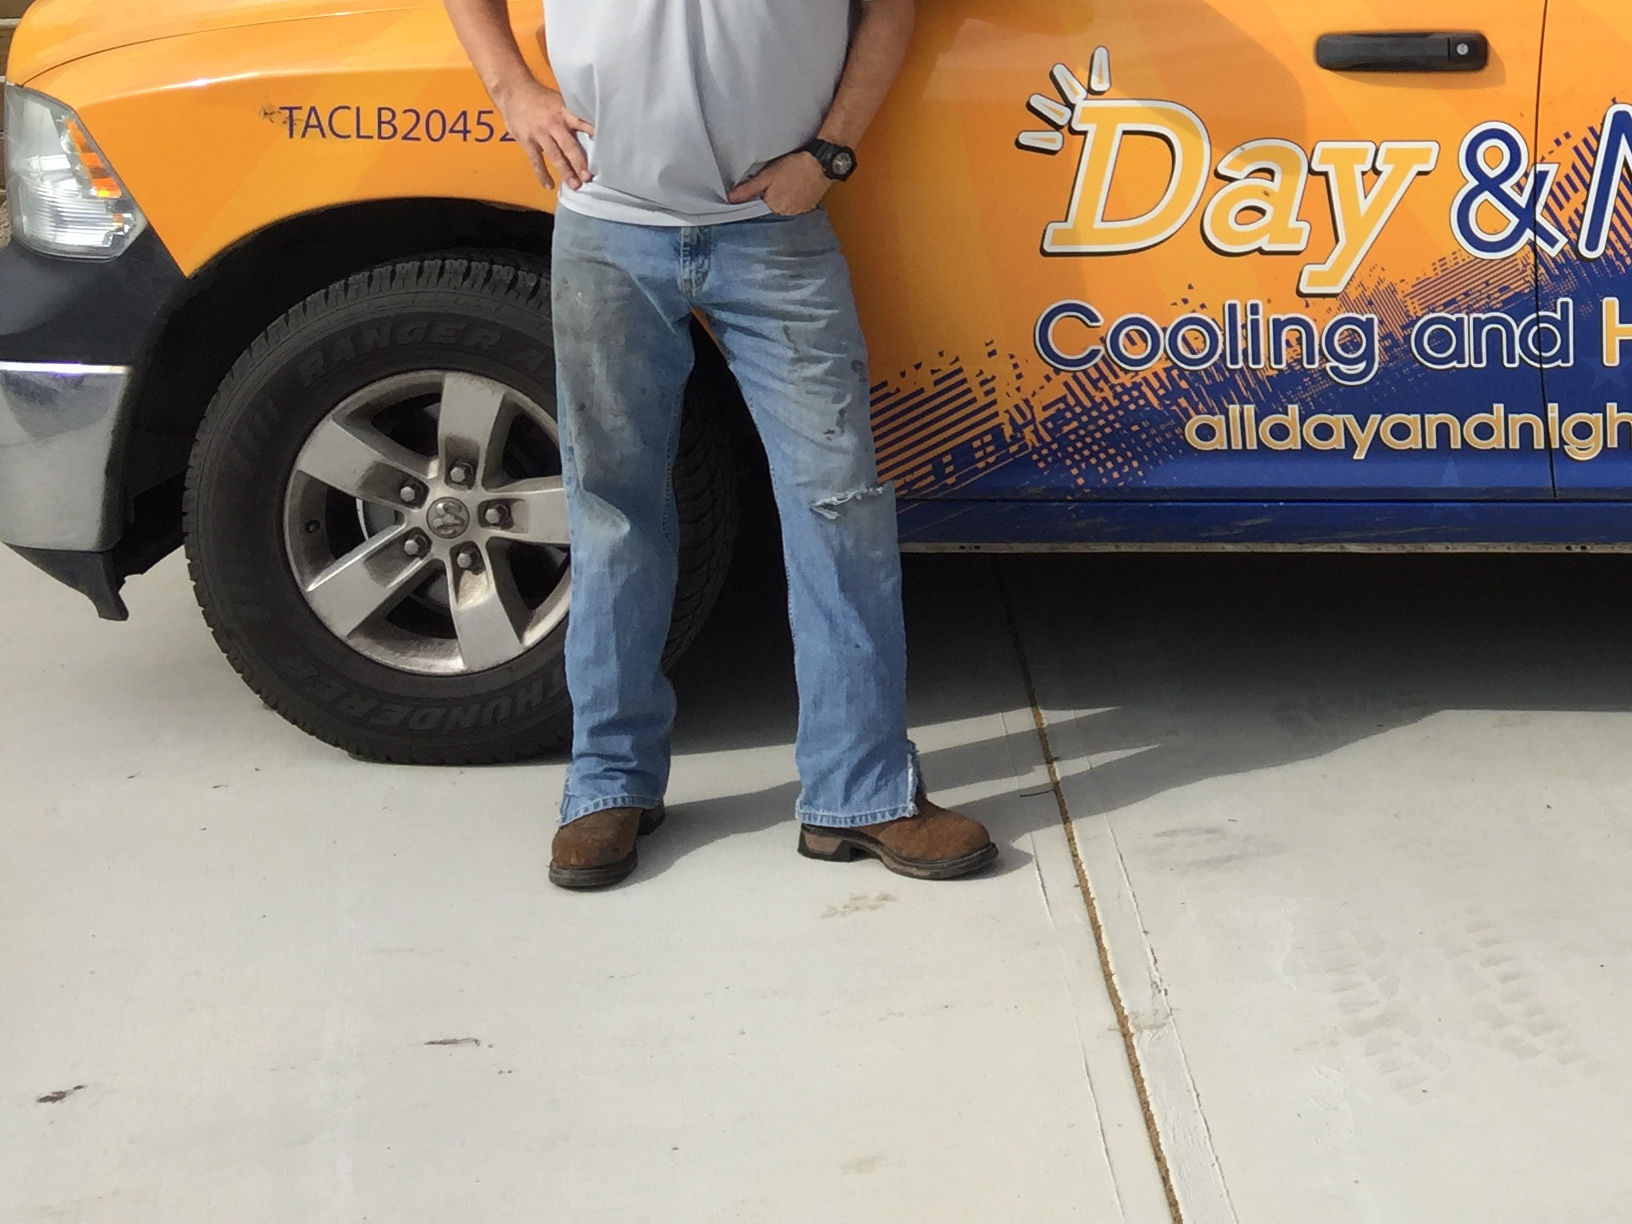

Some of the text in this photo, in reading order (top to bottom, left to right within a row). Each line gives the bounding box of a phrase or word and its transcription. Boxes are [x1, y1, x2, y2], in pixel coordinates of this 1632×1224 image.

[1041, 98, 1440, 295] Day
[1450, 121, 1568, 259] &
[297, 320, 502, 386] RANGER
[1035, 299, 1379, 386] Cooling
[1411, 297, 1574, 369] and
